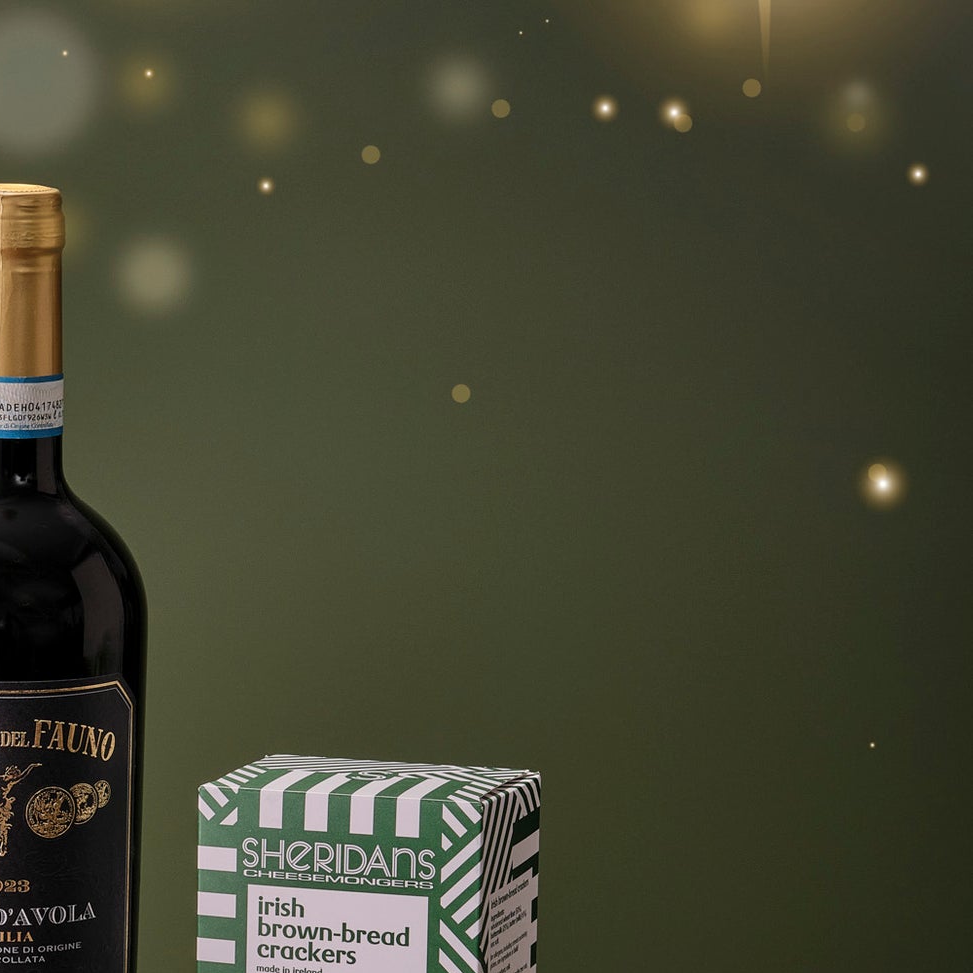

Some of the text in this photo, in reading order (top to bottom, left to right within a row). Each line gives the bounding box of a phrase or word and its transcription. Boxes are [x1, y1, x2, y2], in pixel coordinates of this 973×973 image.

[0, 730, 30, 747] DEL
[31, 718, 116, 762] FAUNO
[243, 869, 434, 890] CHEESEMONGERS
[258, 896, 305, 918] irish
[257, 917, 410, 947] brown-bread
[22, 945, 35, 954] DI
[40, 941, 82, 953] ORIGINE
[257, 941, 357, 964] crackers
[256, 965, 279, 973] made
[282, 966, 290, 973] in
